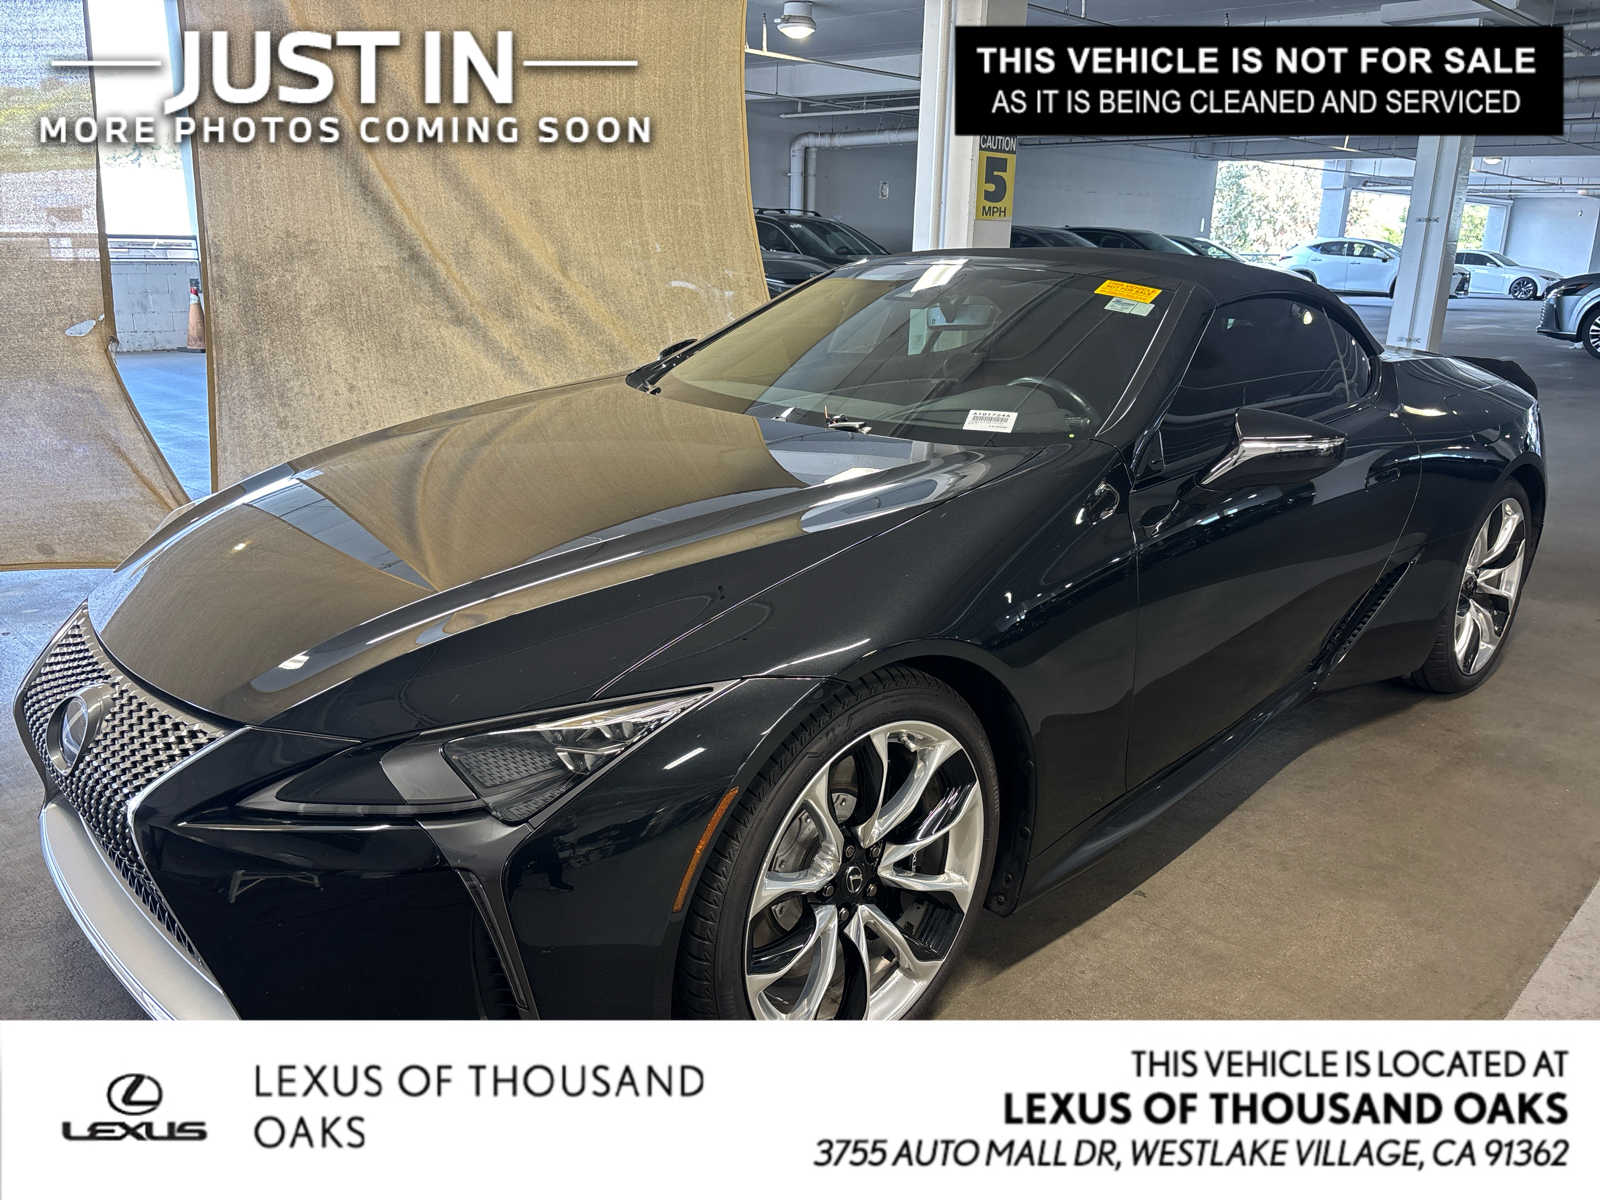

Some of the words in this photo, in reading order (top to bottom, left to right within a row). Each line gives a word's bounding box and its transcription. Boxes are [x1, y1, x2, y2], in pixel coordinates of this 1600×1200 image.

[980, 135, 1016, 151] CAUTION
[983, 156, 1008, 203] 5
[981, 206, 1007, 217] MPH
